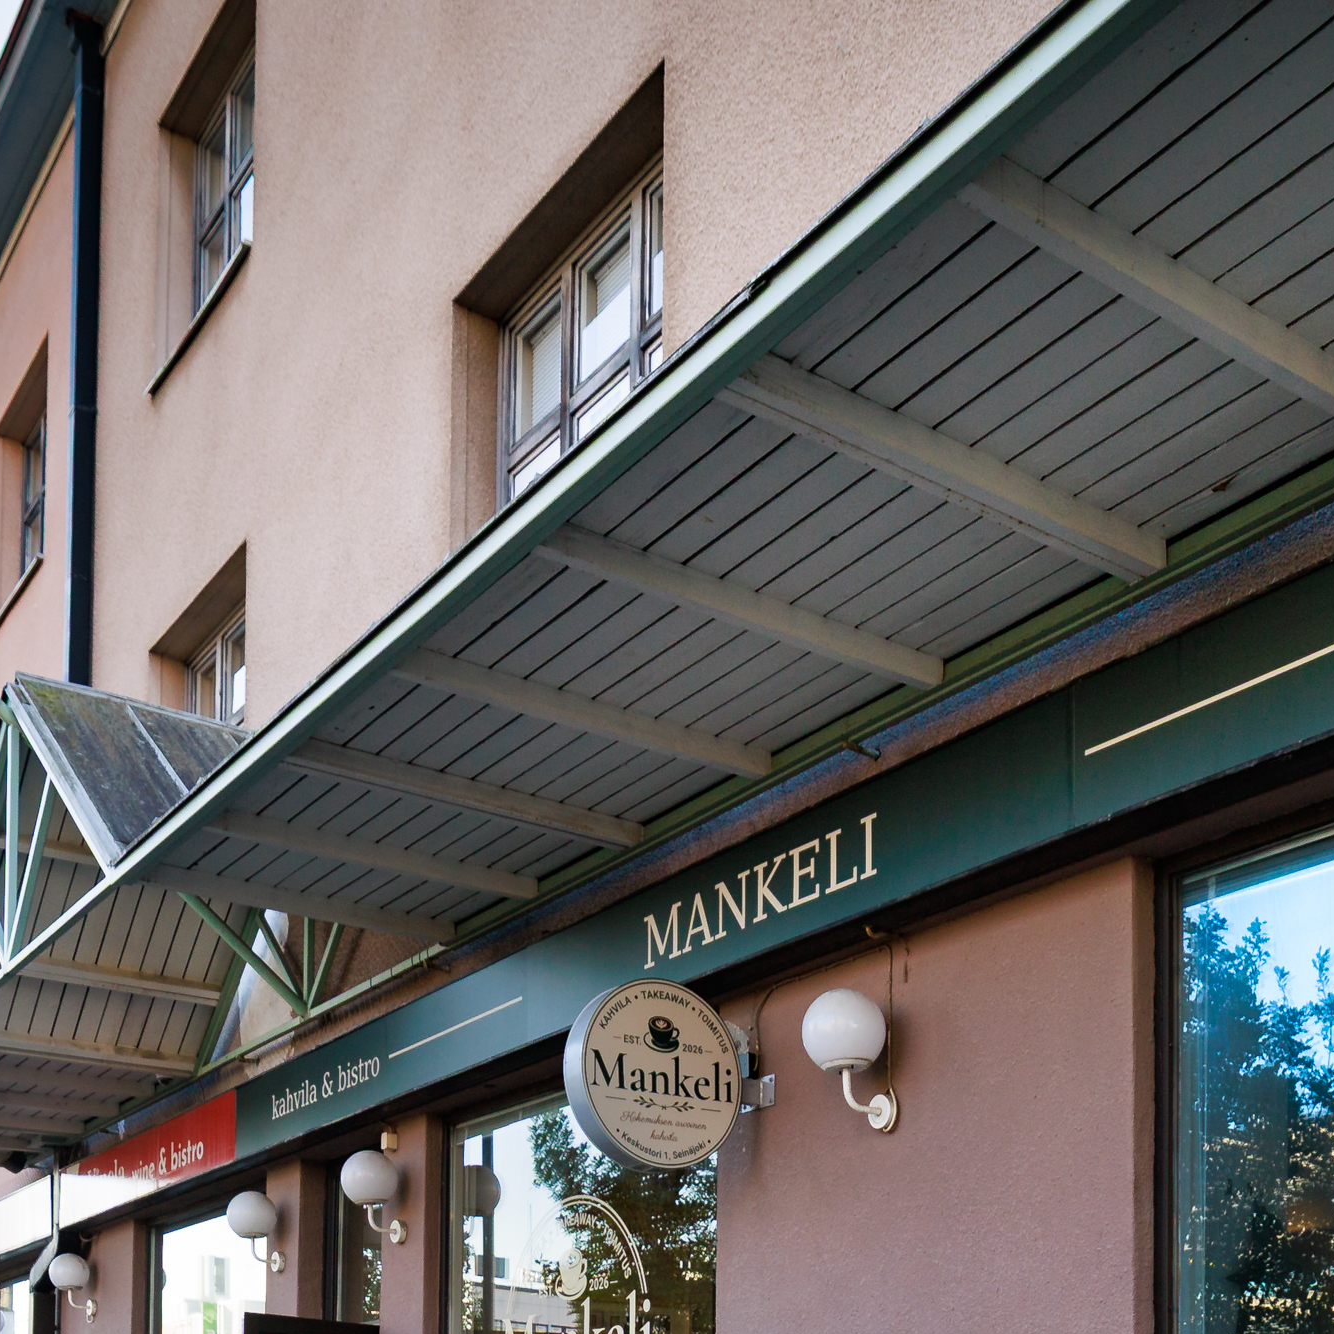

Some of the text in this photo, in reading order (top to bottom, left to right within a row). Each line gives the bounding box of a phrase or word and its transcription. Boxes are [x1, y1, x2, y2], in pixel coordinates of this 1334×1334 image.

[644, 812, 877, 969] MANKELI
[598, 990, 730, 1054] KAHVILA TAKEAWAY TOIMITUS
[623, 1034, 703, 1054] EST. 2026
[271, 1056, 380, 1120] kahvila & bistro
[590, 1048, 733, 1103] Mankeli
[620, 1111, 673, 1127] Kokemuksen
[650, 1129, 678, 1142] kahvila
[158, 1147, 167, 1175] &
[170, 1140, 204, 1171] bistro
[621, 1132, 662, 1159] Keskustori
[673, 1141, 707, 1159] Seinäjoki
[602, 1222, 632, 1279] TOIMITUS
[589, 1276, 609, 1291] 2026
